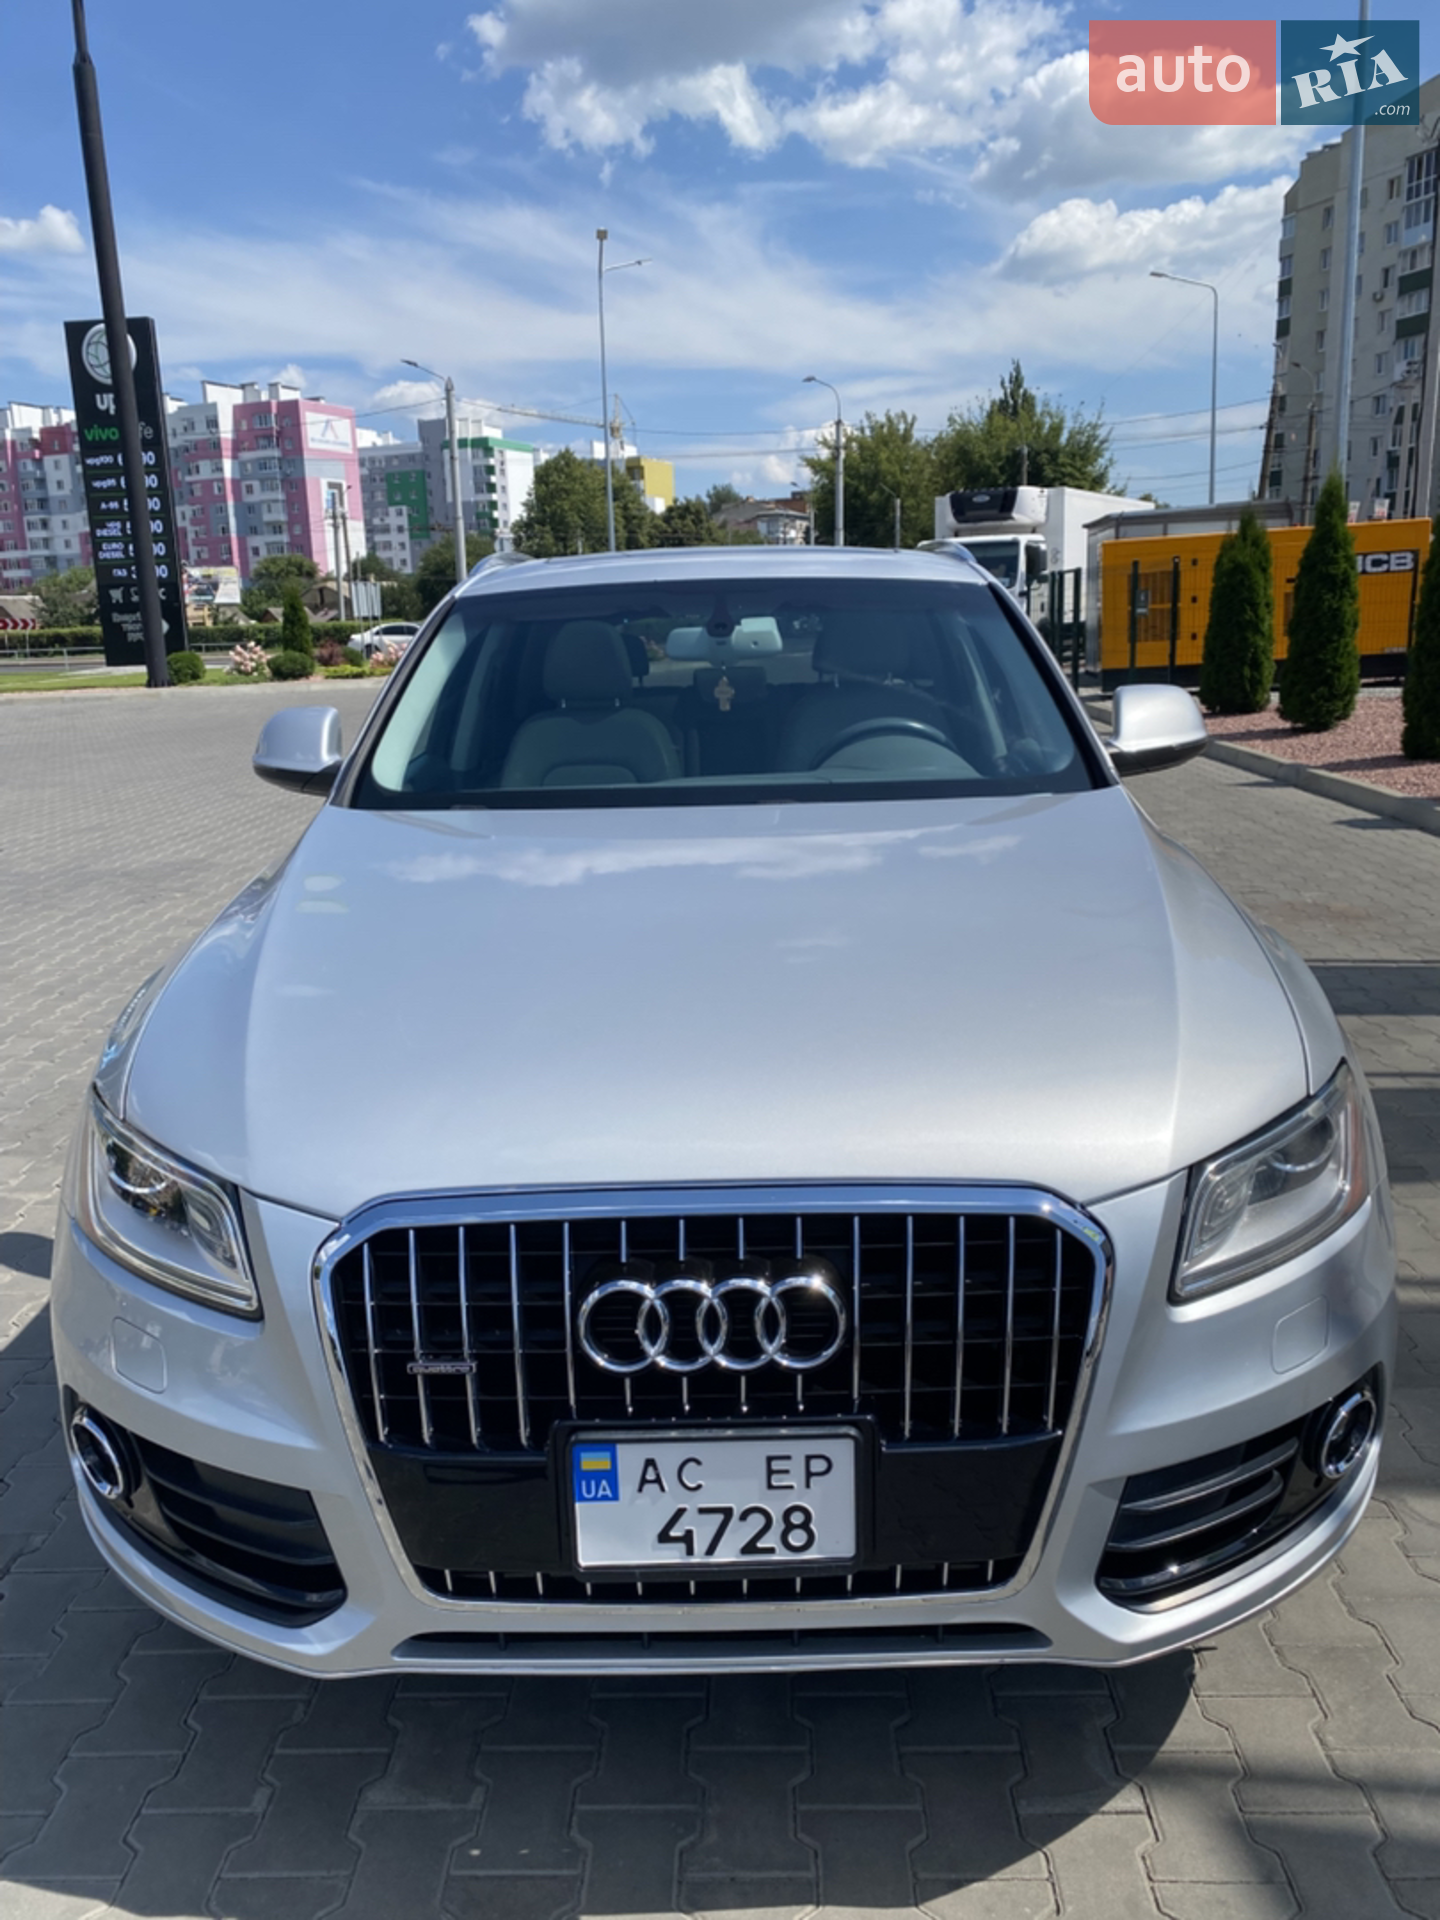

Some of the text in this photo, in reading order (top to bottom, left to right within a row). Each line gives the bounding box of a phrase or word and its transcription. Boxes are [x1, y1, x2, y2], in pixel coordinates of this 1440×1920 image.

[84, 424, 120, 441] vivo
[581, 1480, 612, 1499] UA
[657, 1503, 816, 1556] 4728
